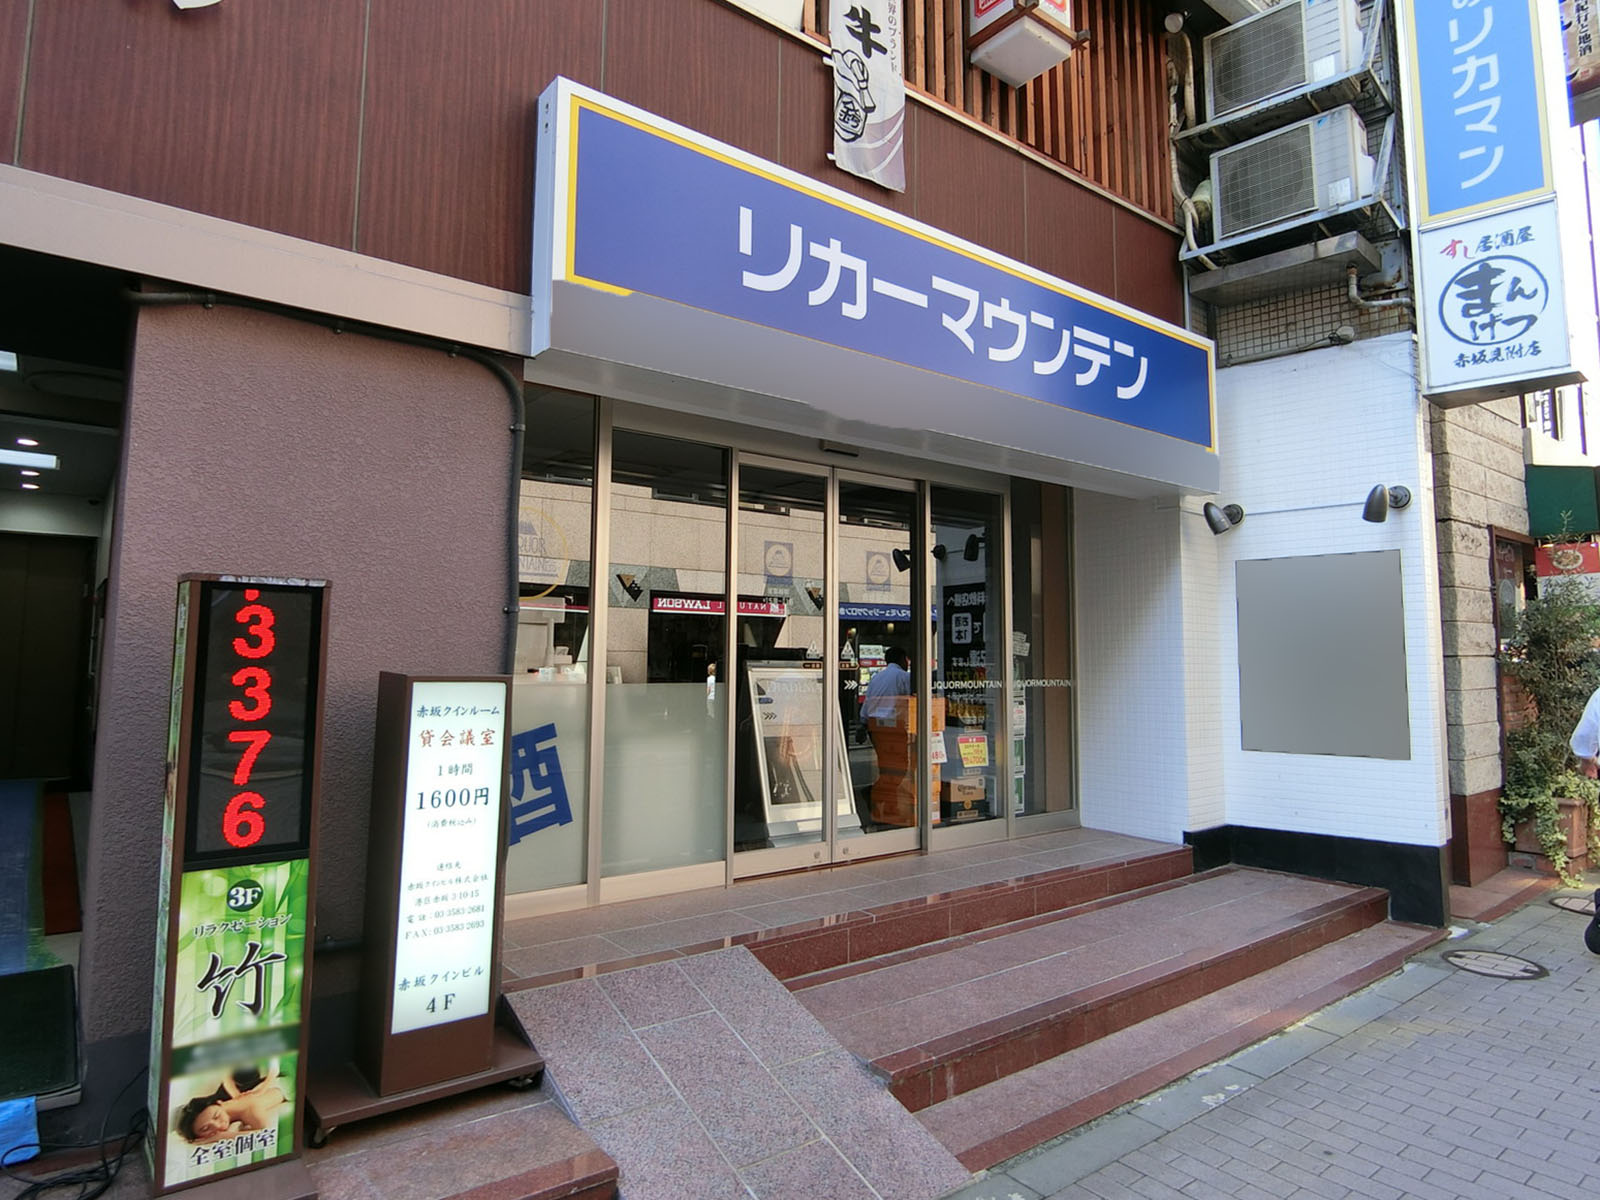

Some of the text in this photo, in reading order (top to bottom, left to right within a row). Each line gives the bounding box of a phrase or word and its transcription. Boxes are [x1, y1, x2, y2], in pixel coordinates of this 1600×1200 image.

[845, 3, 888, 59] 牛
[739, 206, 1148, 399] リカーマウンテン
[1453, 340, 1542, 368] 赤坂見附店
[223, 589, 276, 848] 3376
[416, 705, 500, 718] 赤坂クインルーム
[419, 728, 495, 747] 貸会議室
[416, 787, 489, 810] 1600円
[229, 887, 261, 907] 3F
[194, 913, 293, 937] リラクゼーション
[196, 941, 287, 1018] 竹
[398, 966, 484, 991] 赤坂クインビル
[426, 993, 456, 1013] 4F
[190, 1129, 277, 1165] 全室個室
